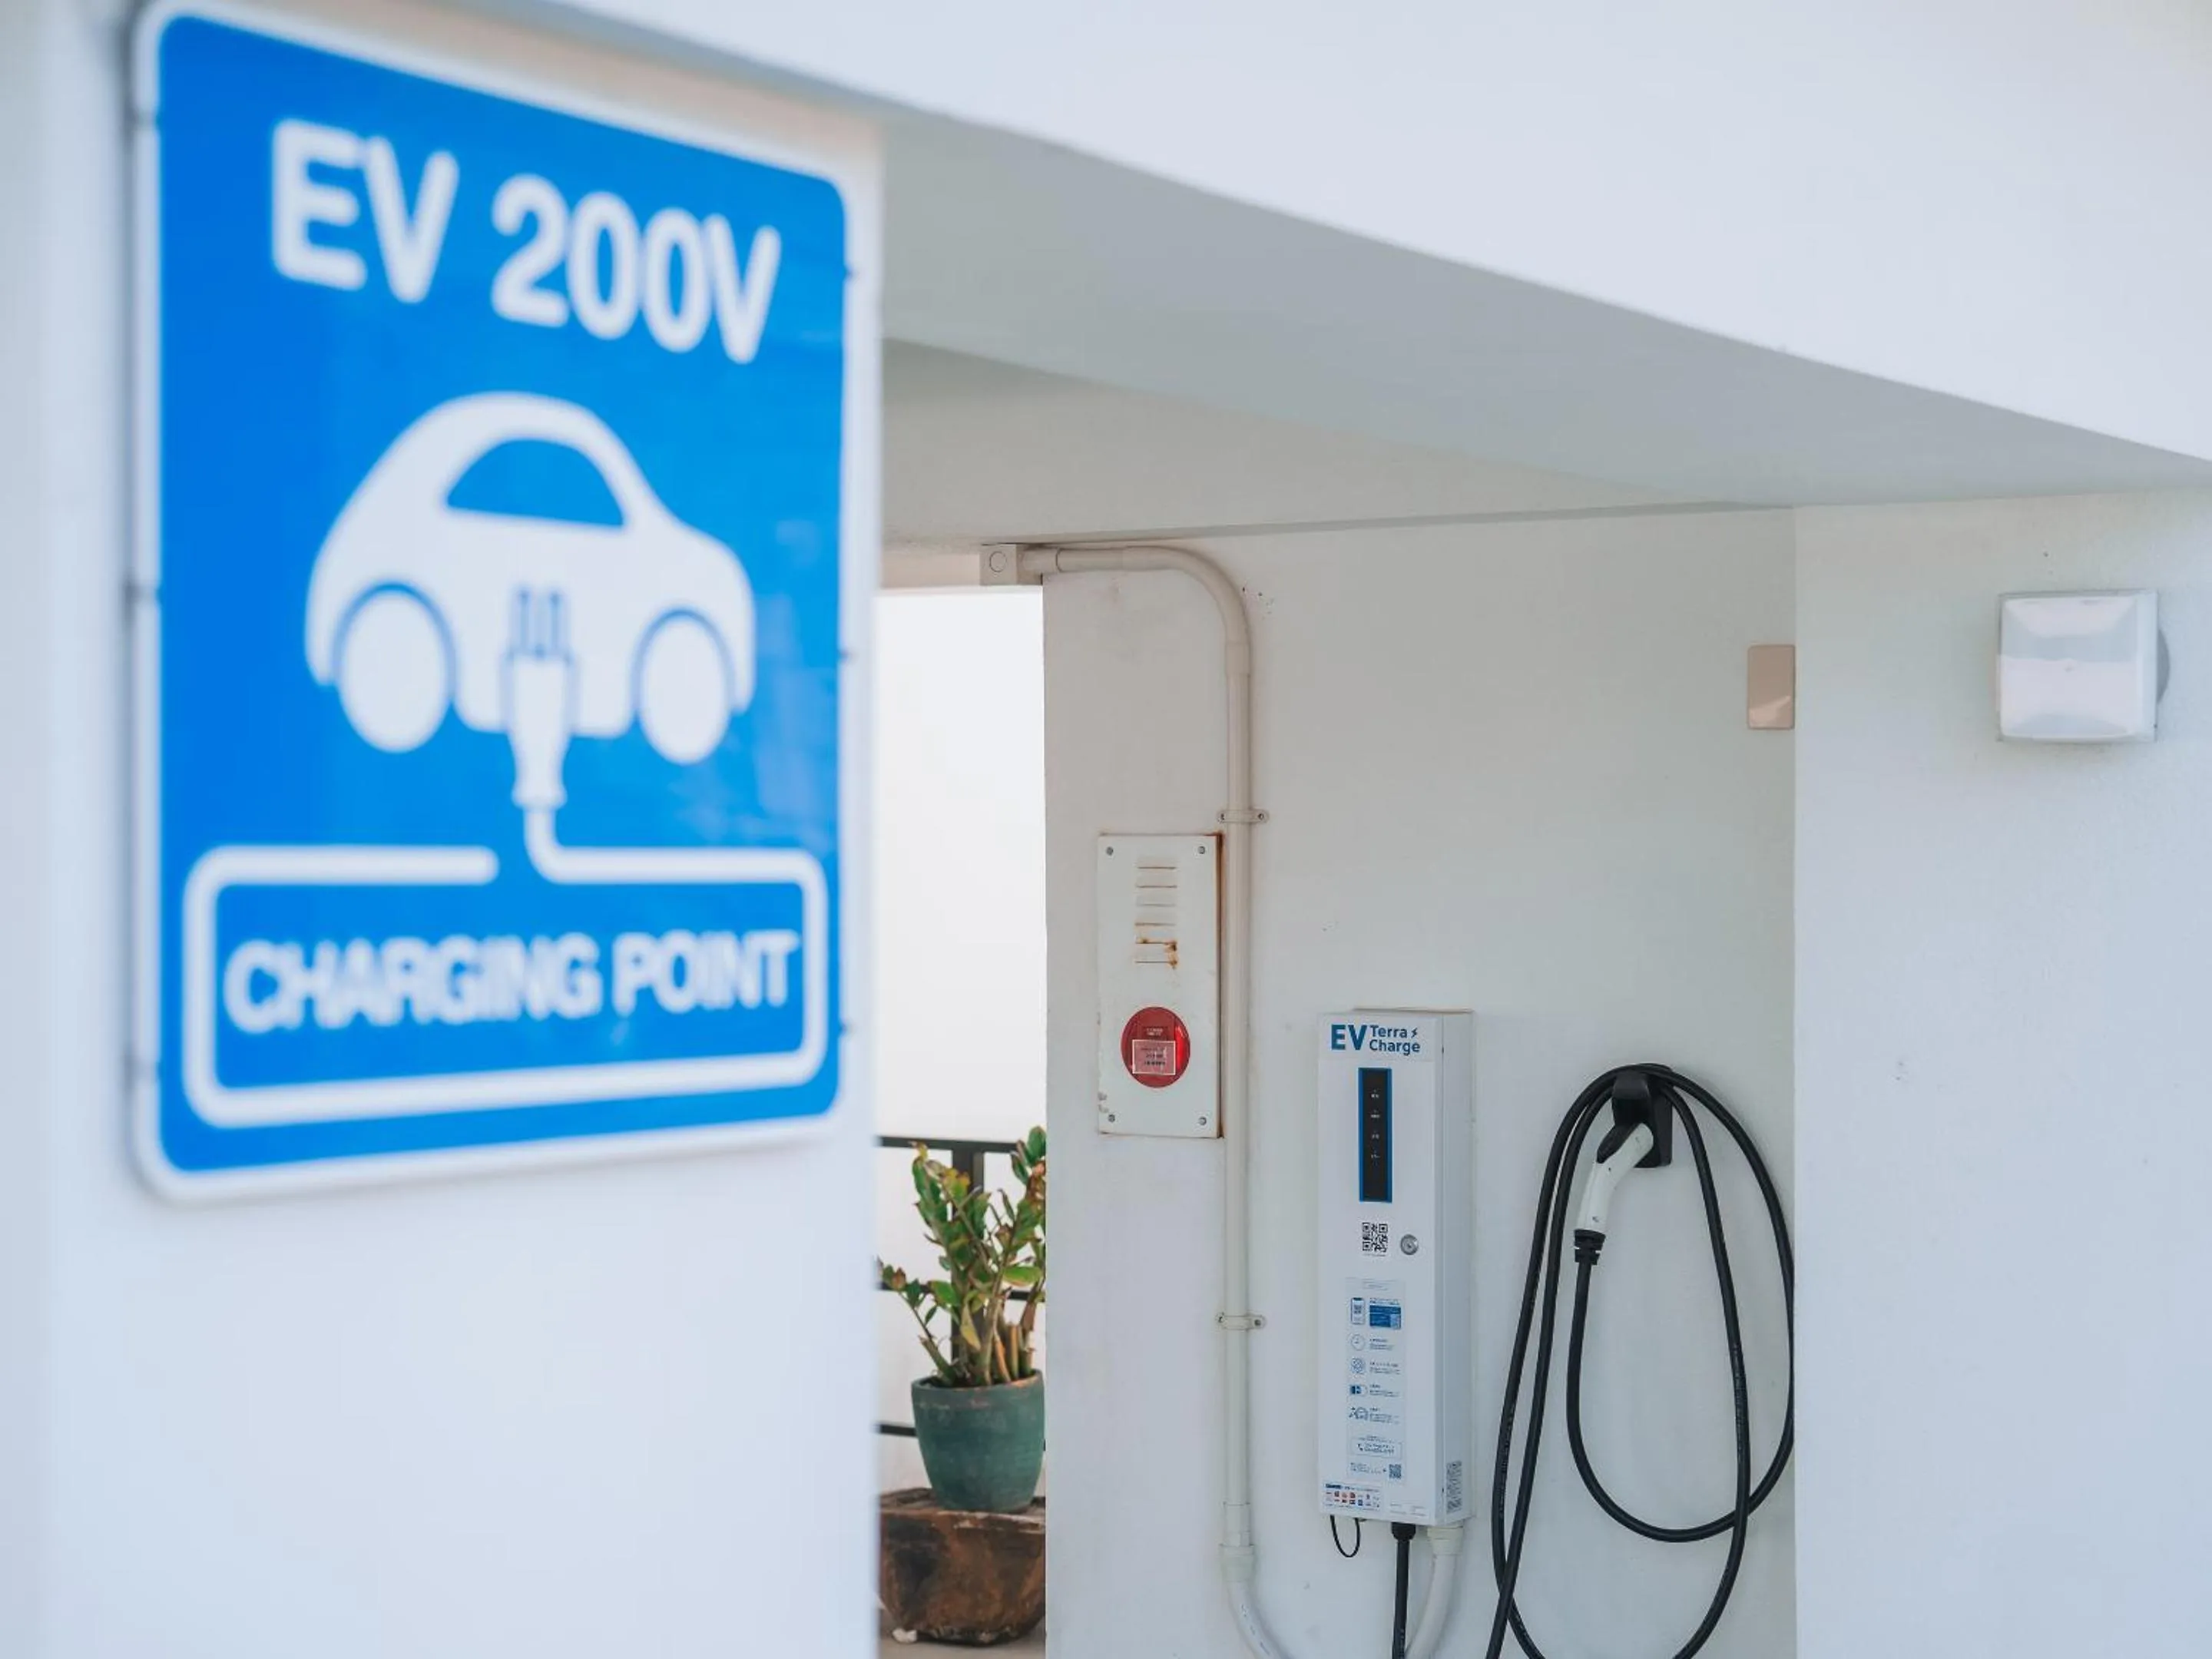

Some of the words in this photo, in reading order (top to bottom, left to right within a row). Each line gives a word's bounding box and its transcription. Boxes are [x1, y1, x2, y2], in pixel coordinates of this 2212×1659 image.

[272, 118, 460, 303] EV
[490, 173, 782, 364] 200V
[223, 934, 603, 1035] CHARGING
[612, 929, 801, 1015] POINT
[1331, 1025, 1367, 1050] EV
[1369, 1025, 1407, 1038] Terra
[1369, 1039, 1420, 1055] Charge
